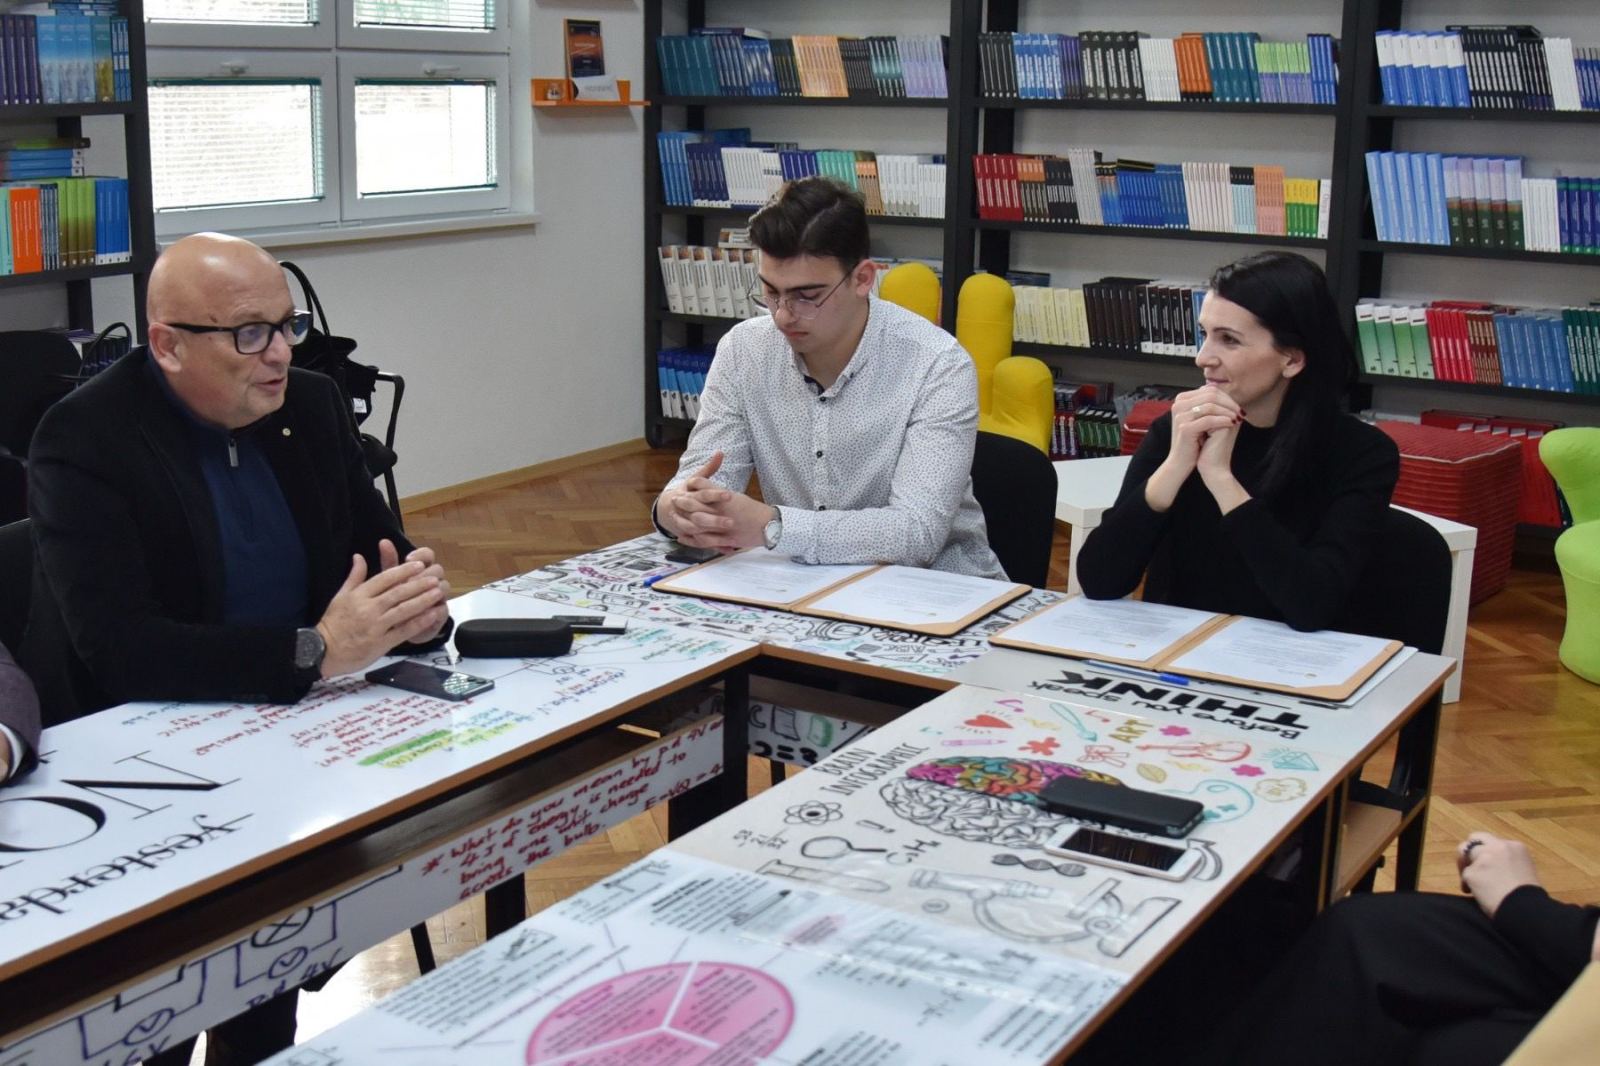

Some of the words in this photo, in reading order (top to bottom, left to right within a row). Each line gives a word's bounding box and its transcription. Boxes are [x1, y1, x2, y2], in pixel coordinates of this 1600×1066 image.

[1027, 680, 1119, 703] speak
[1048, 669, 1309, 730] THINK
[1130, 700, 1184, 716] you
[1108, 719, 1155, 744] ART
[1192, 712, 1301, 740] Before
[812, 748, 877, 778] BRAIN
[820, 742, 931, 797] INFOGRAPHIC
[607, 761, 661, 797] needed
[452, 824, 495, 858] What
[573, 768, 623, 798] mean
[460, 854, 505, 886] bring
[523, 846, 554, 866] the
